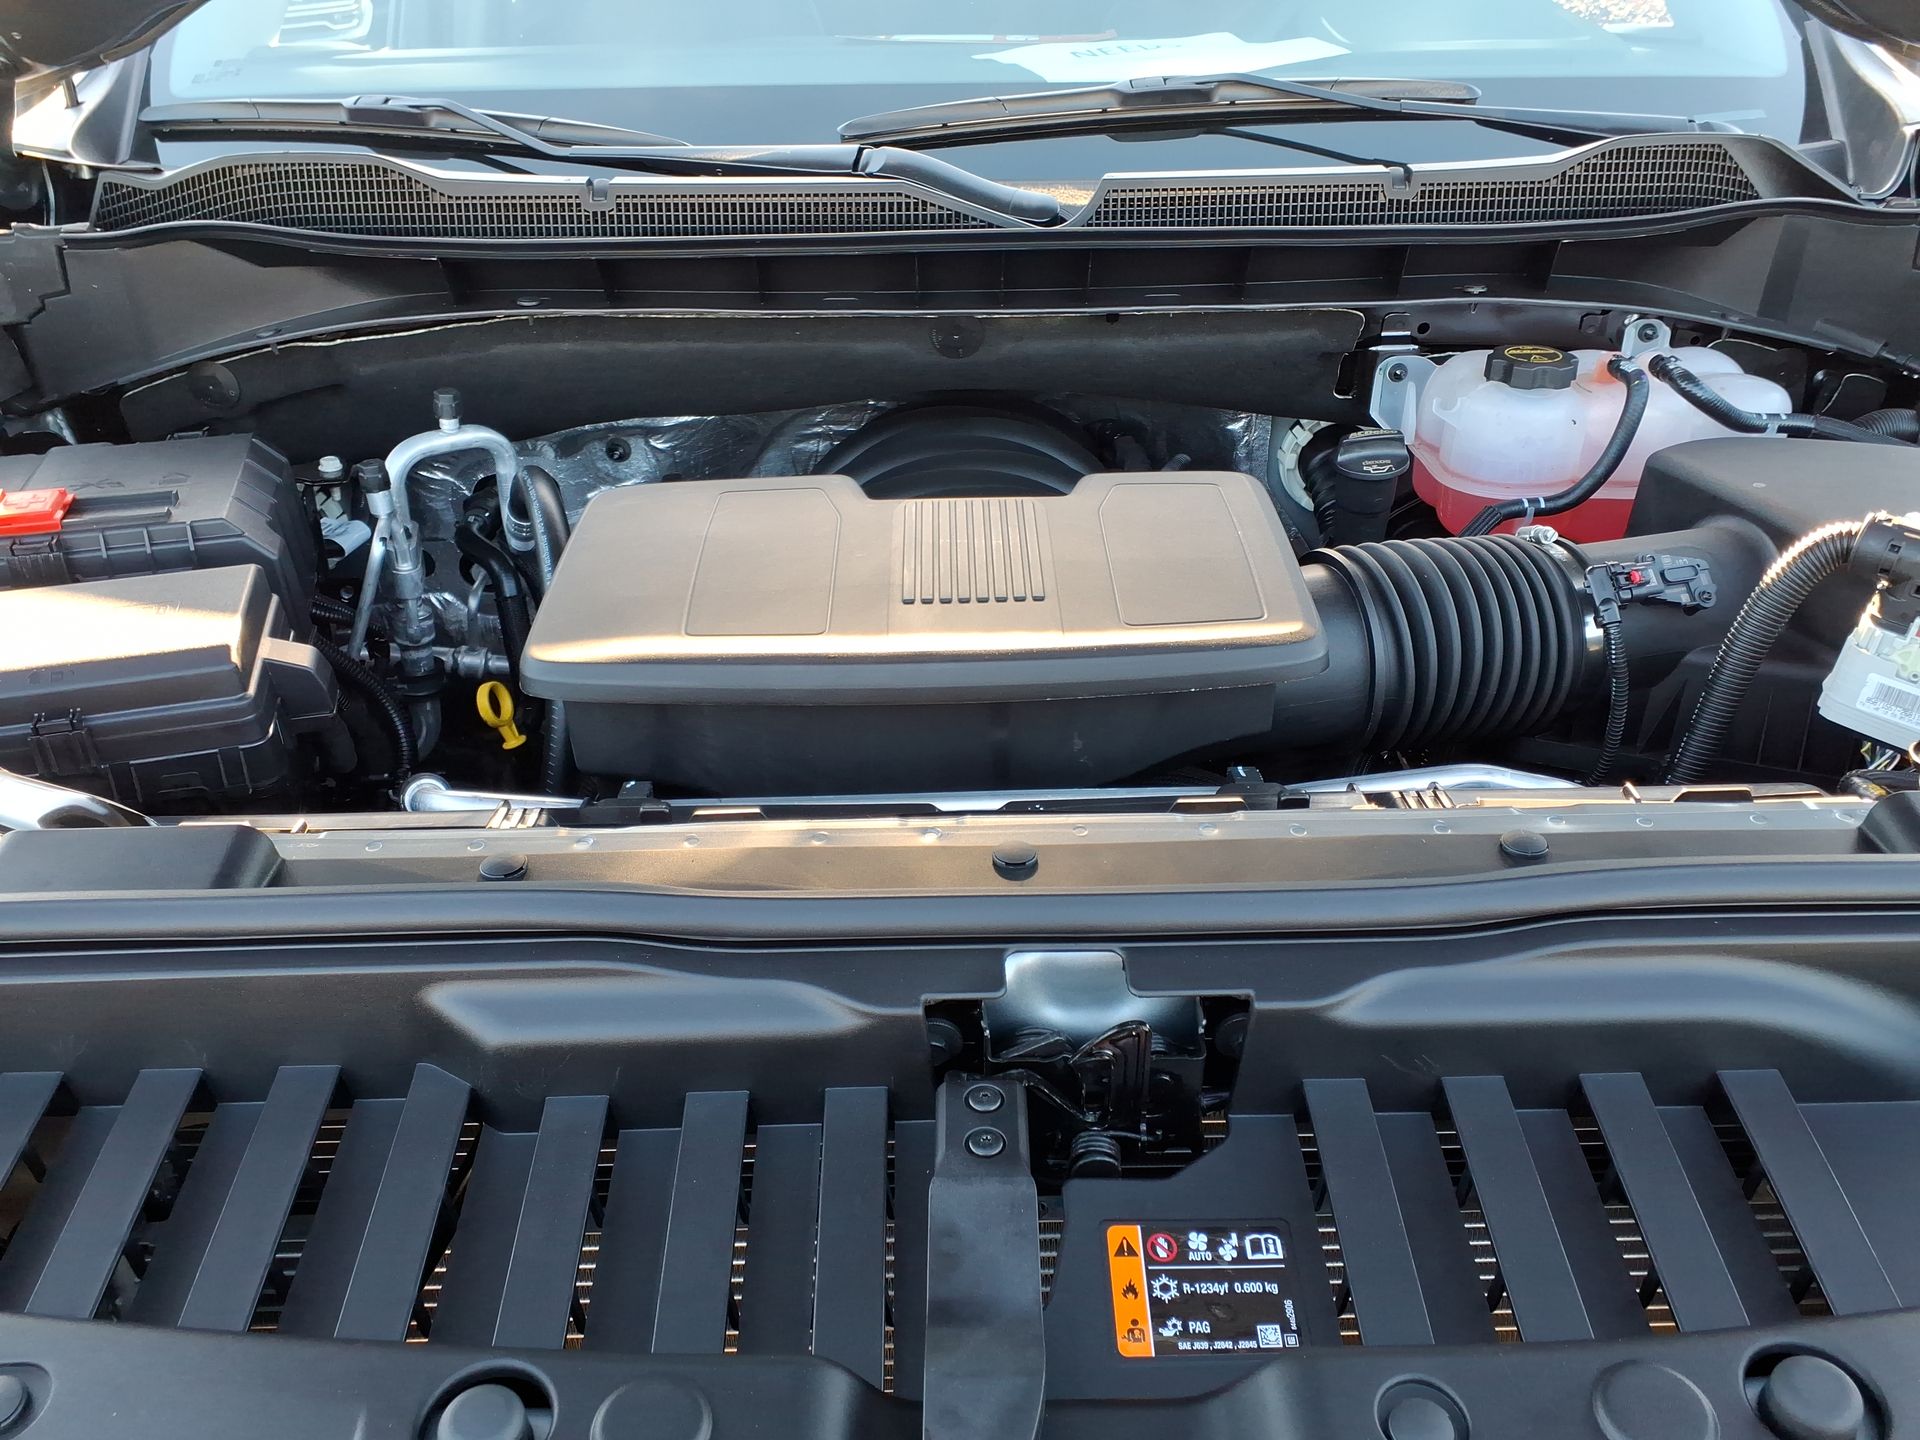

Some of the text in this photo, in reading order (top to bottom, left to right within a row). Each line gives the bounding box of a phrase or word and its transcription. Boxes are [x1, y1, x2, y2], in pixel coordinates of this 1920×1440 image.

[1189, 1251, 1212, 1261] AUTO
[1183, 1281, 1279, 1296] R-1234yf 0.600 kg
[1189, 1321, 1211, 1334] PAG
[1178, 1341, 1191, 1350] SAE
